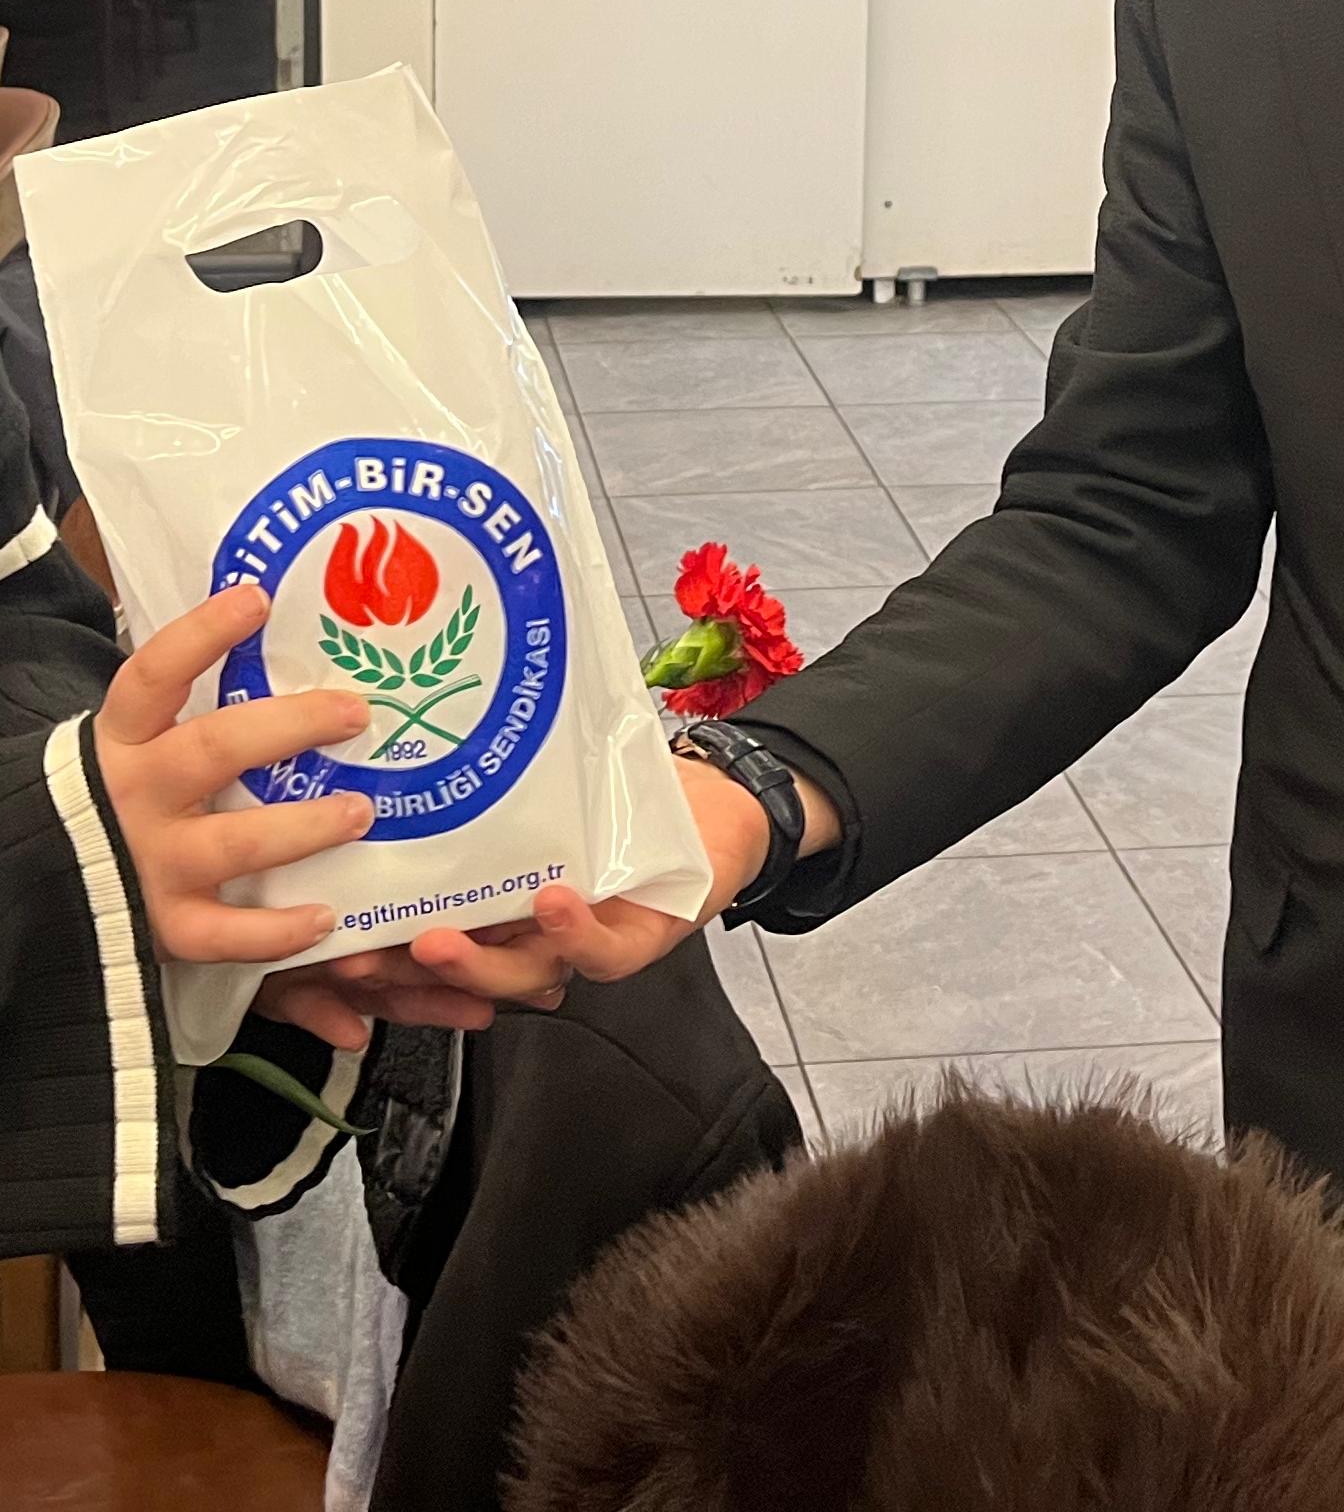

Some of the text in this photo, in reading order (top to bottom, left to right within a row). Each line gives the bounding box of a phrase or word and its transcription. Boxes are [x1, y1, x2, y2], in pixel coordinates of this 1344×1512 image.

[375, 617, 552, 818] BİRLİĞİ SENDİKASI
[331, 863, 565, 931] .egitimbirsen.org.tr
